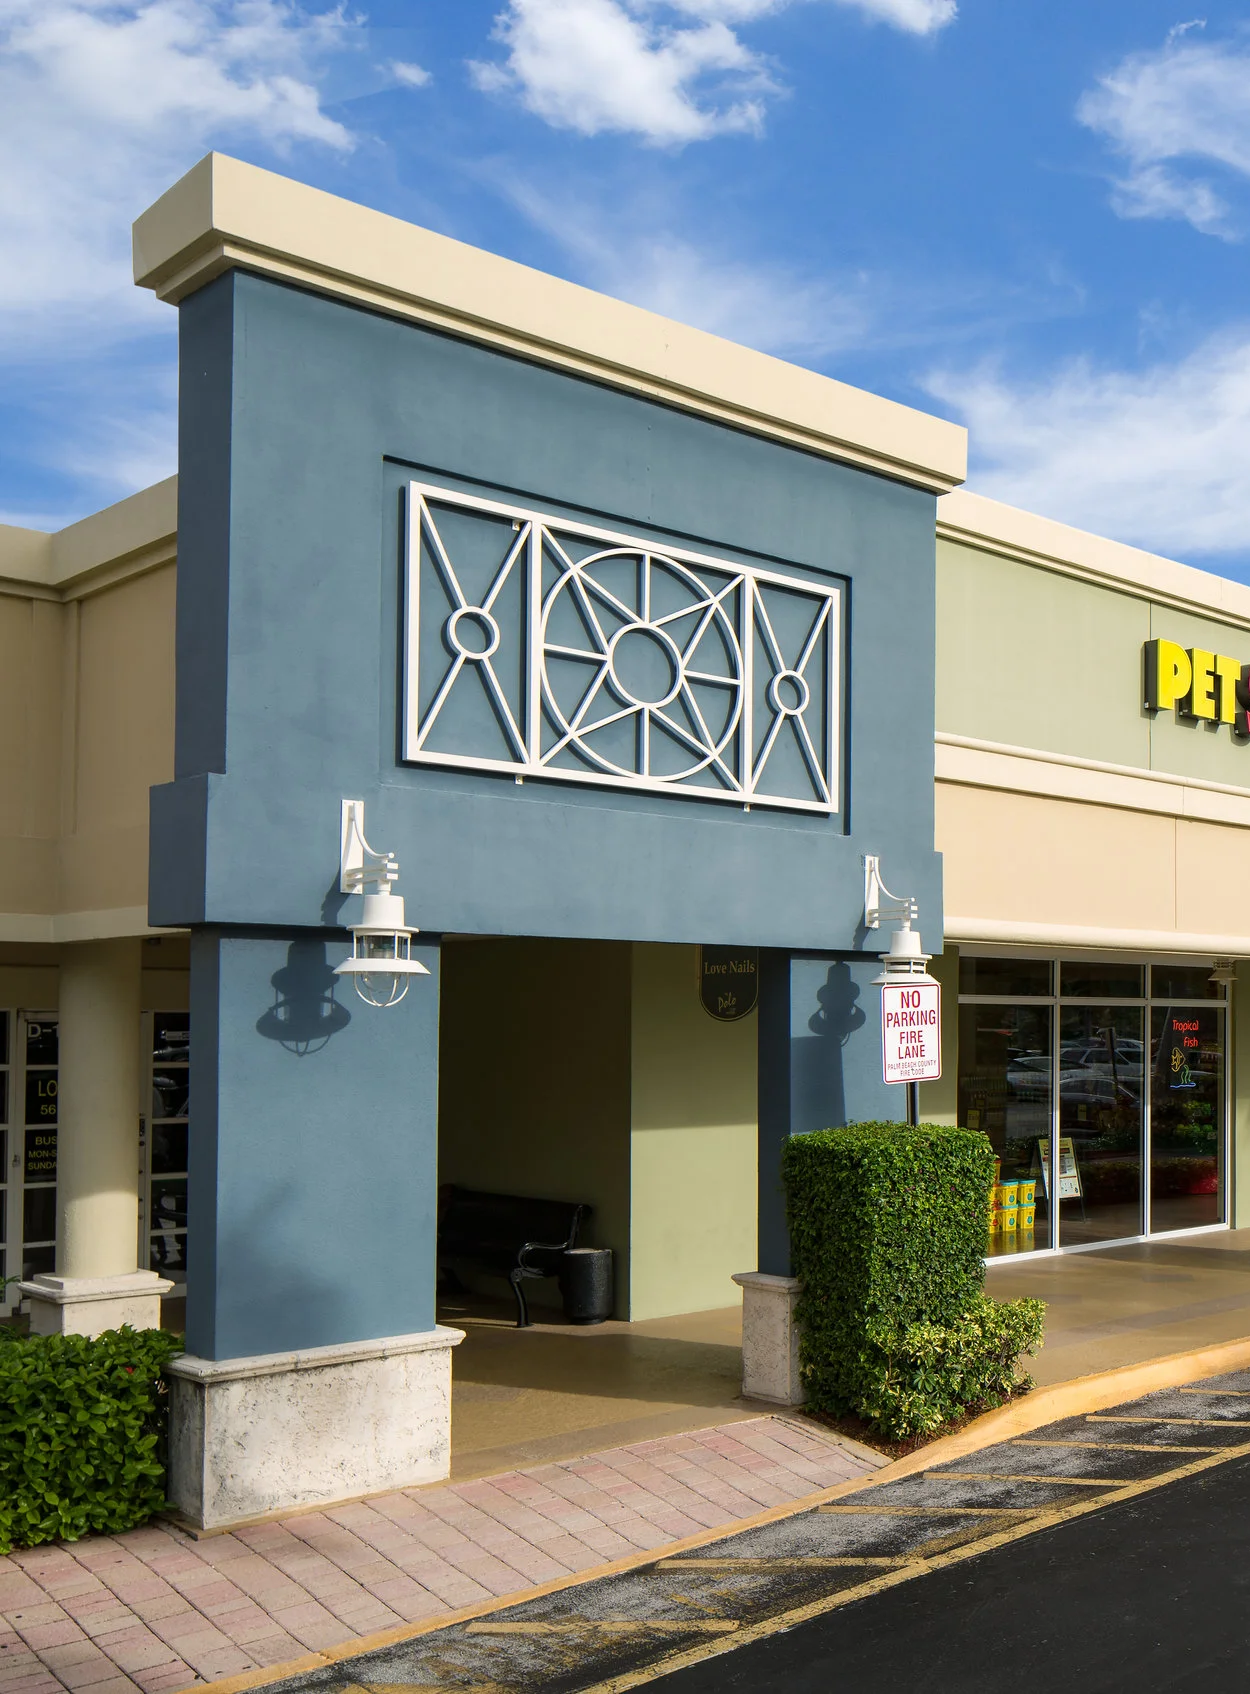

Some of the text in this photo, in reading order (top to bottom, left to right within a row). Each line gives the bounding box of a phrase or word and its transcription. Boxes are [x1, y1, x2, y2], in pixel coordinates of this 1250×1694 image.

[1148, 637, 1241, 725] PET
[704, 959, 756, 975] Love Nails
[901, 990, 921, 1009] NO
[886, 1009, 936, 1028] PARKING
[1172, 1019, 1199, 1033] Tropical
[899, 1030, 924, 1045] FIRE
[898, 1044, 926, 1060] LANE
[887, 1059, 937, 1070] PALM BEACH COUNTY
[900, 1067, 925, 1077] FIRE CODE
